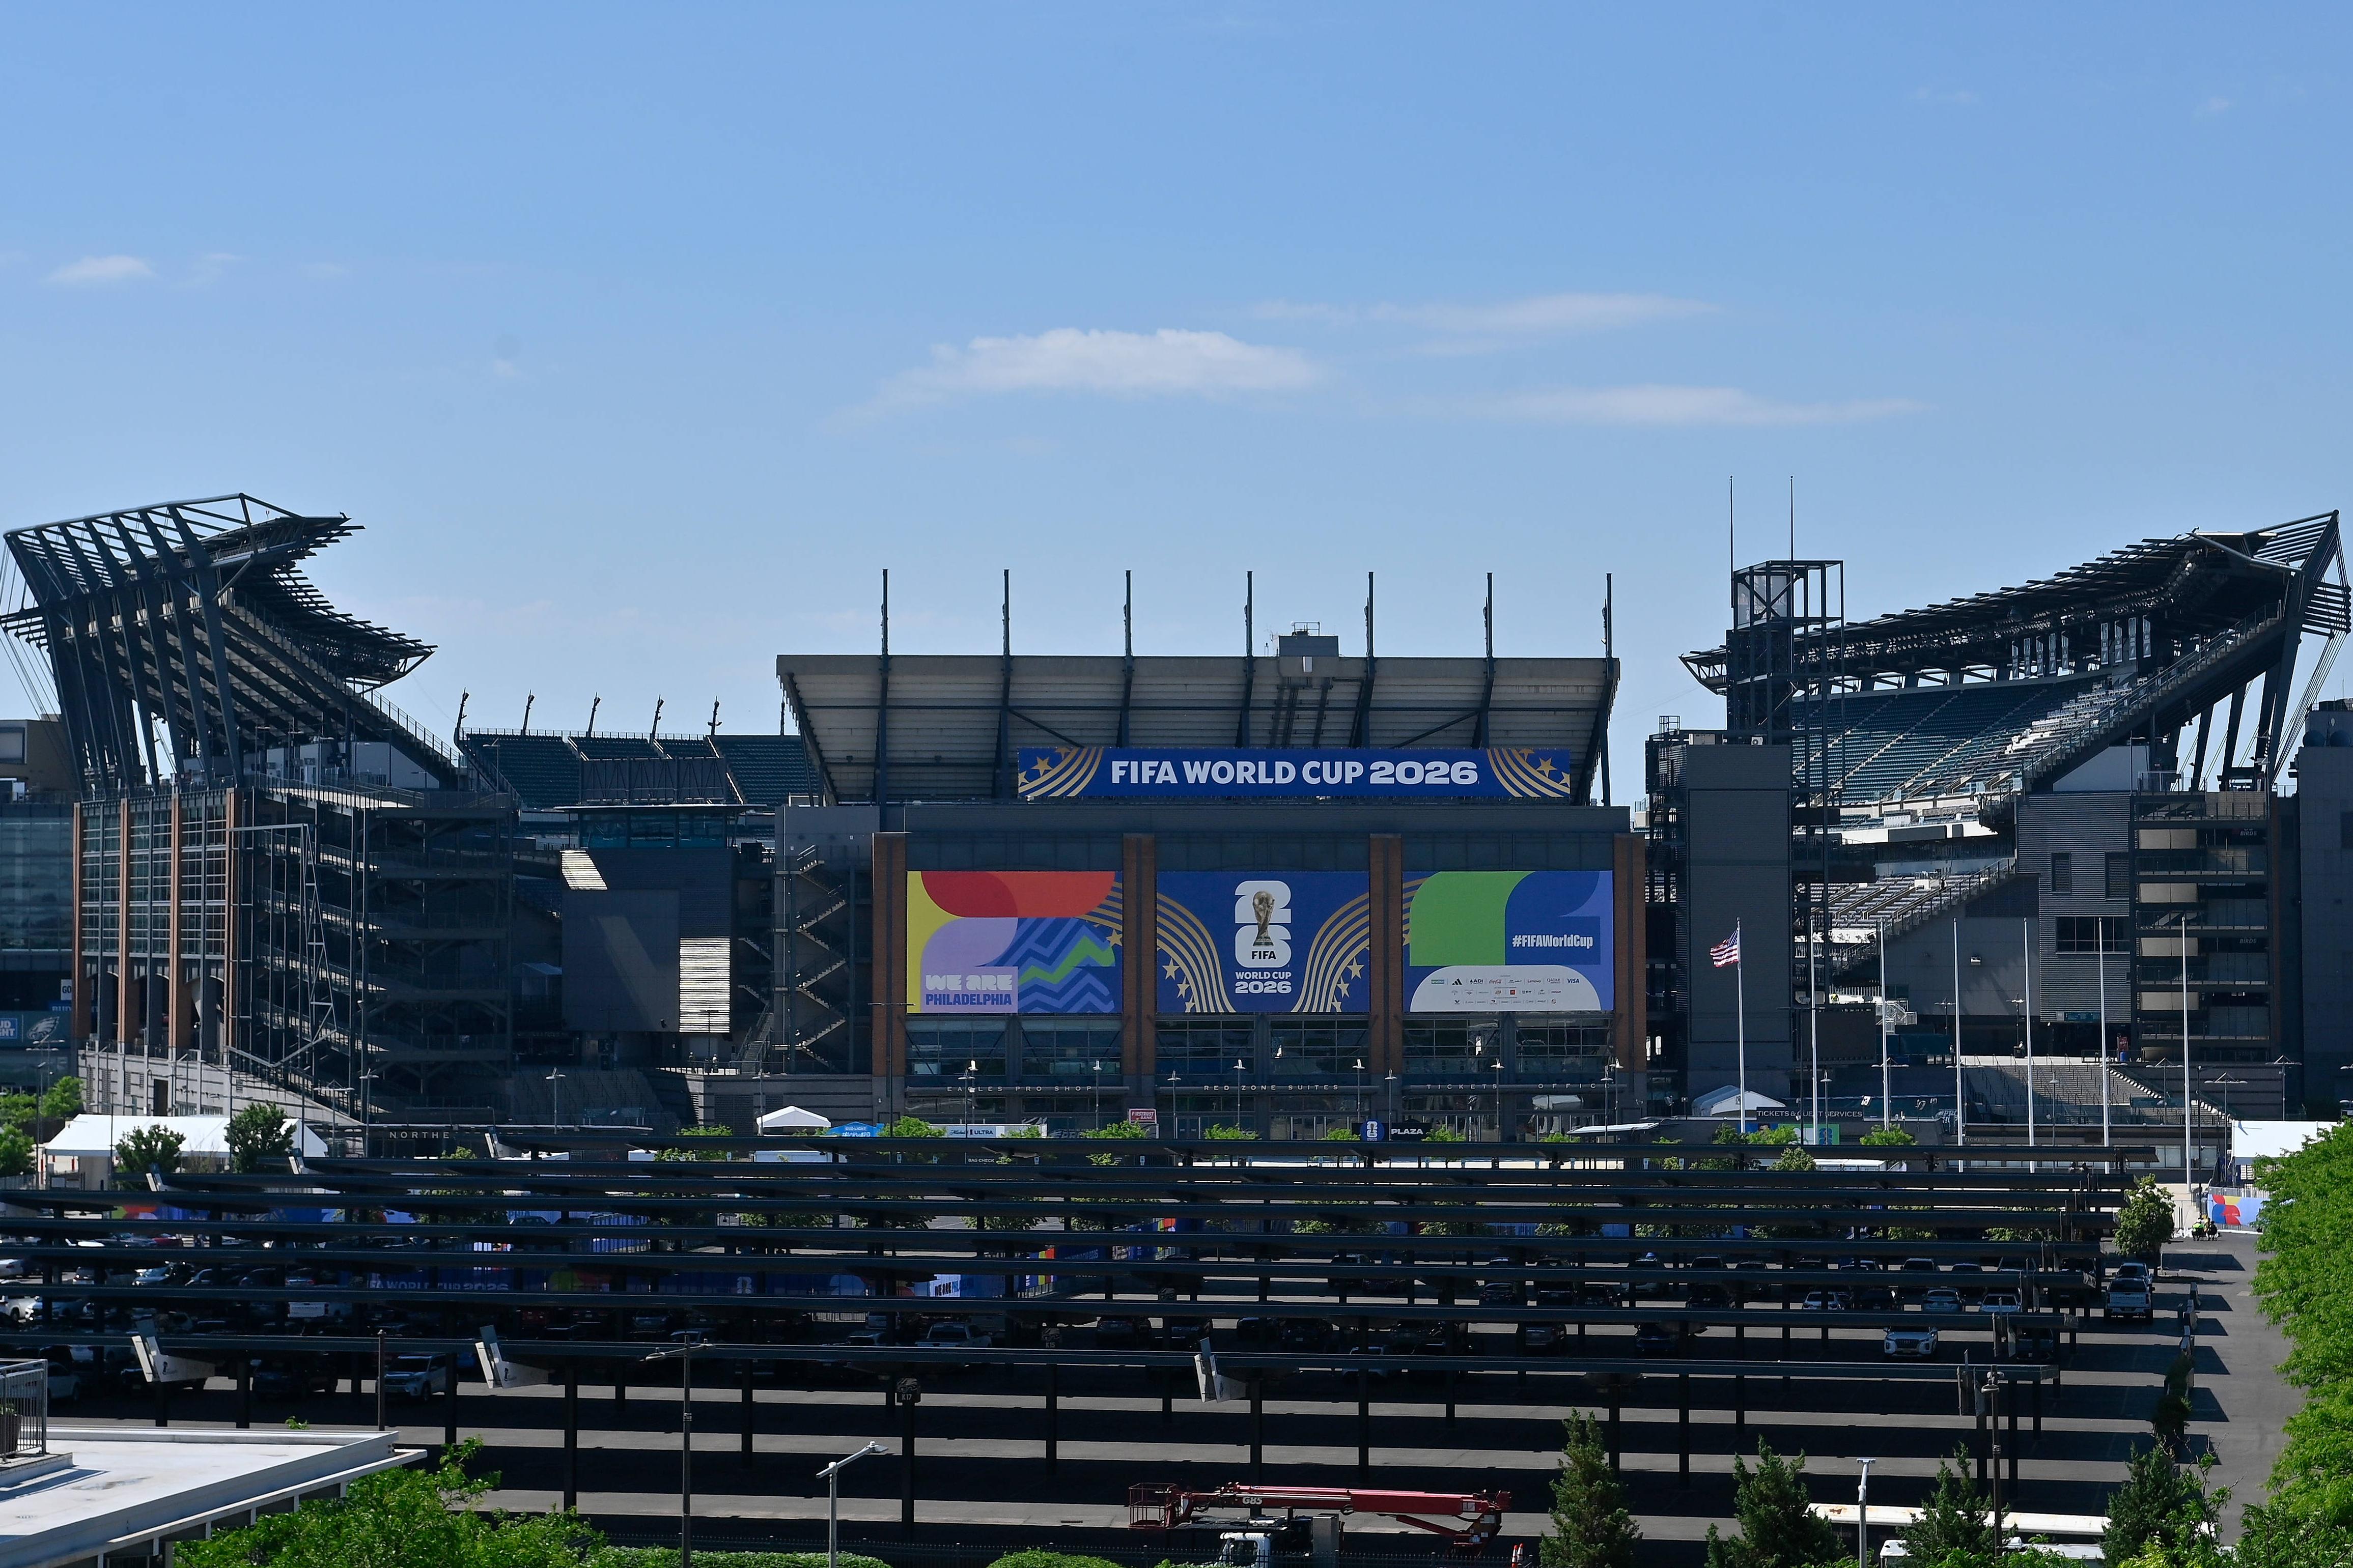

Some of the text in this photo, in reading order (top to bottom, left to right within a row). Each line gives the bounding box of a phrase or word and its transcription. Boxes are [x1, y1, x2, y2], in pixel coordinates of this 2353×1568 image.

[1112, 761, 1477, 784] FIFA WORLD CUP 2026
[1512, 934, 1593, 949] #FIFAWorldCup
[1251, 951, 1276, 960] FIFA
[1235, 971, 1292, 979] WORLD CUP
[926, 975, 1013, 991] WE ARE
[1235, 981, 1292, 993] 2026
[926, 993, 1012, 1006] PHILADELPHIA
[1242, 1497, 1263, 1505] G85
